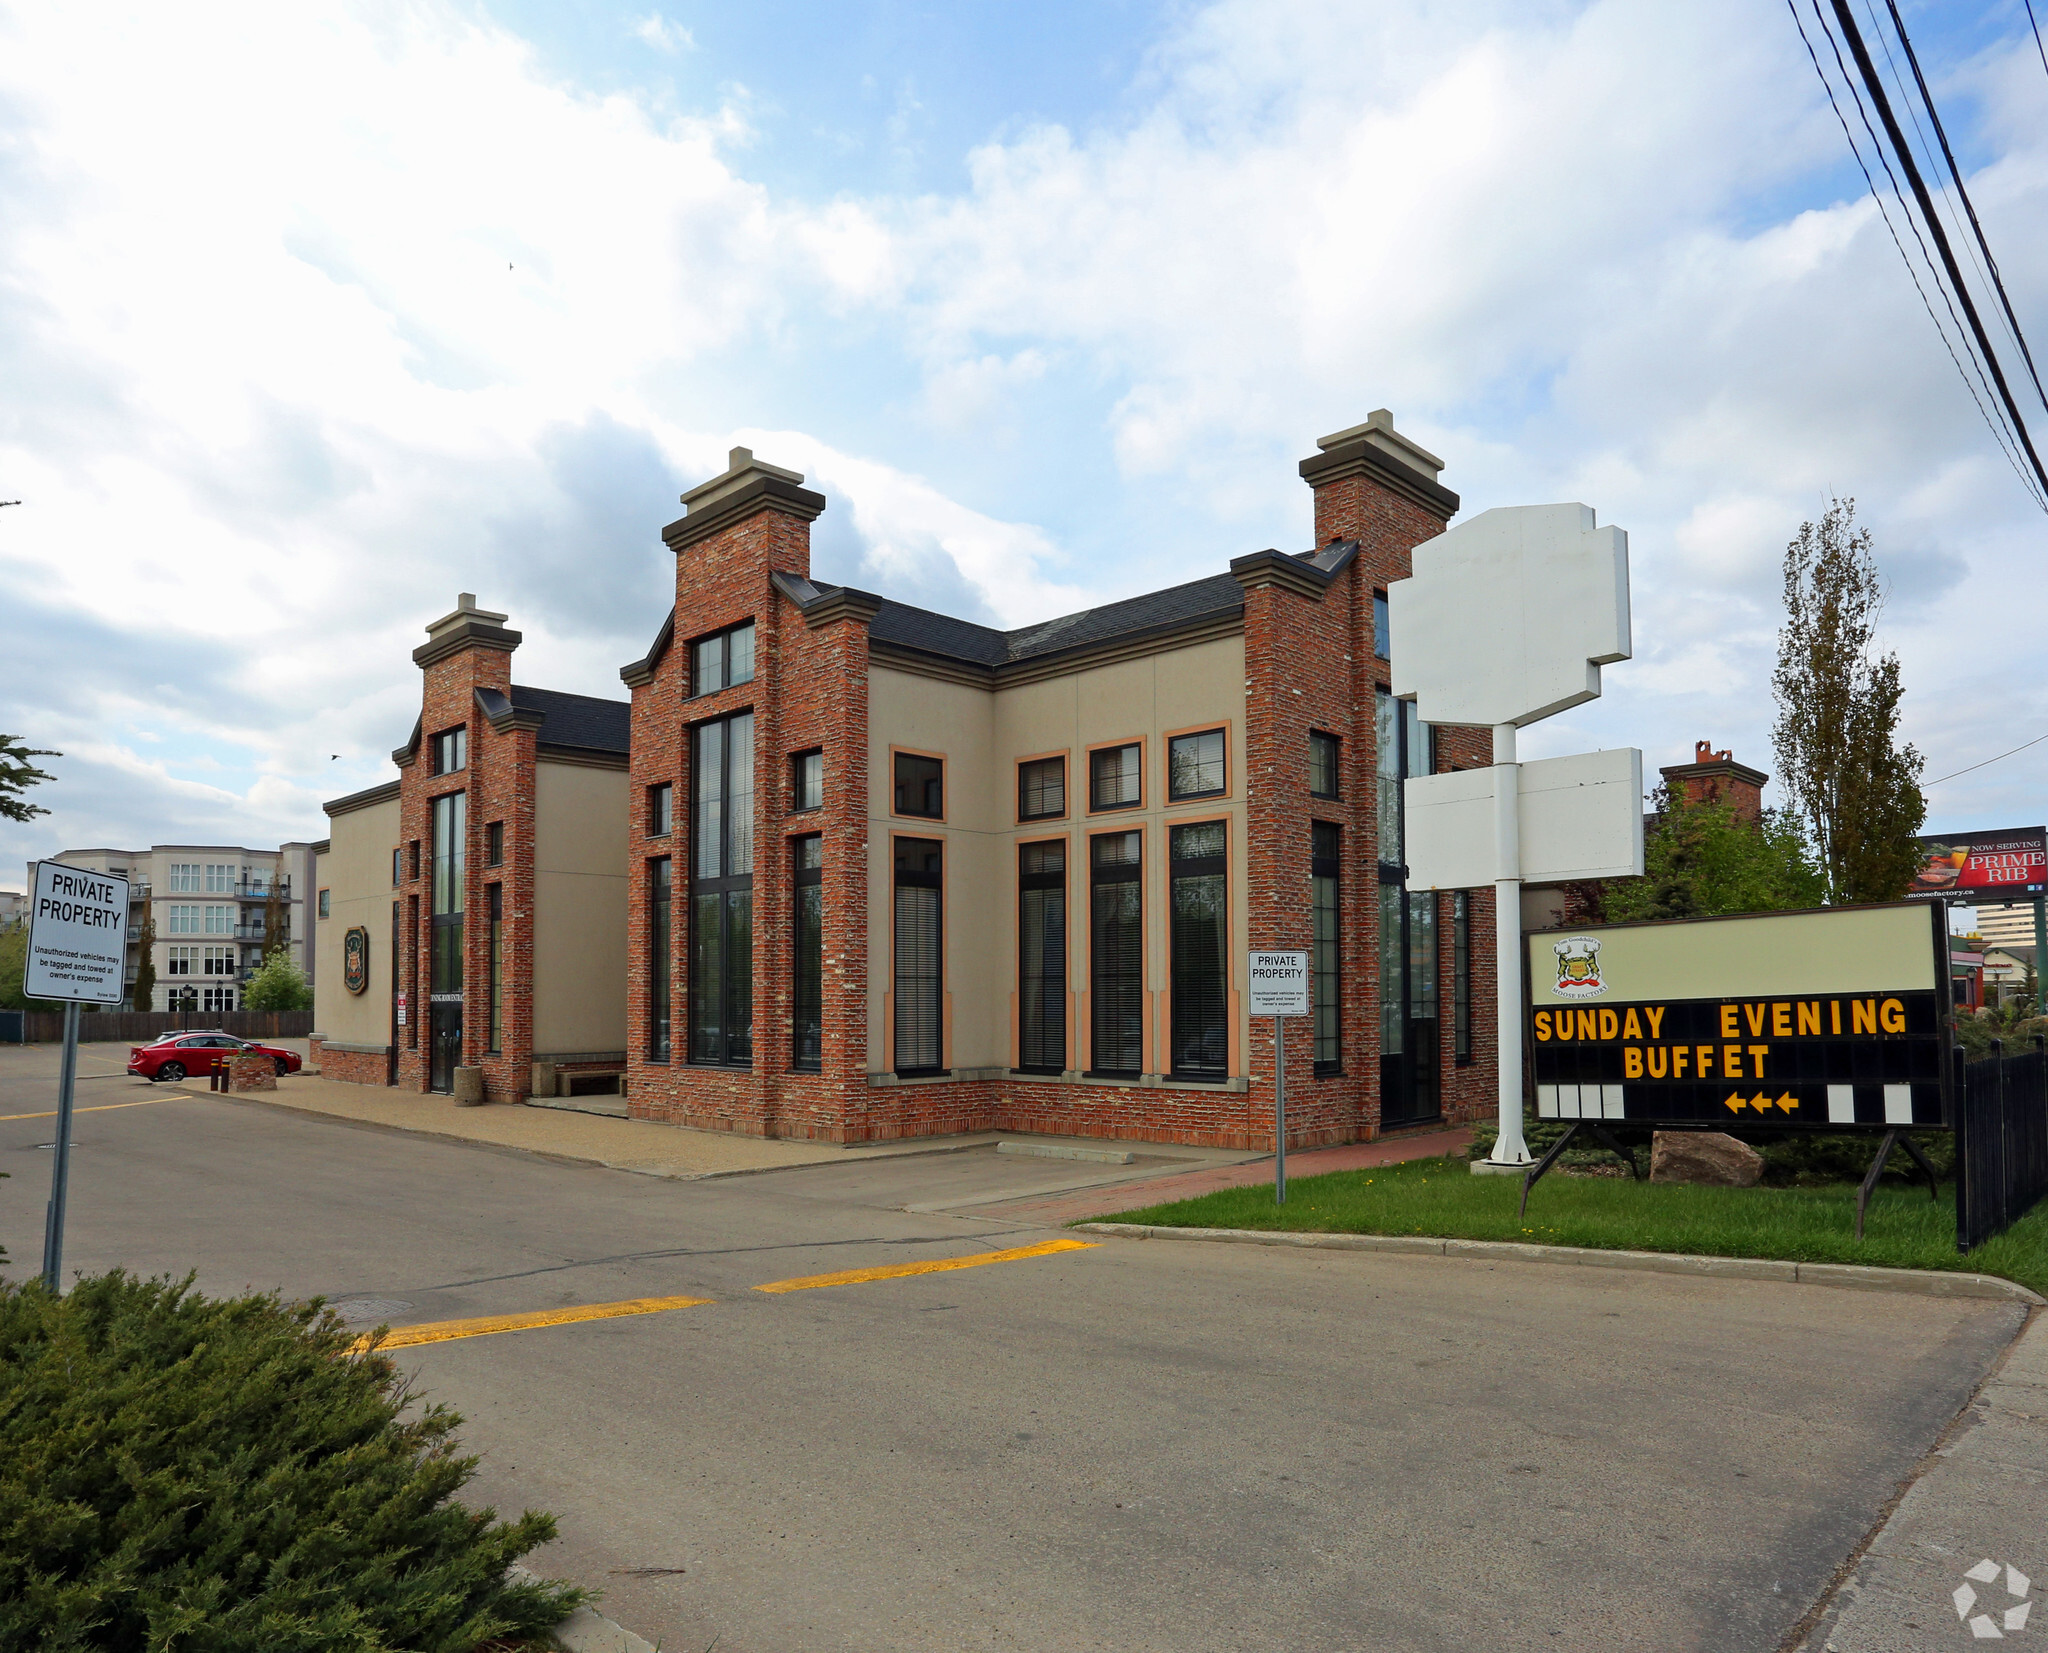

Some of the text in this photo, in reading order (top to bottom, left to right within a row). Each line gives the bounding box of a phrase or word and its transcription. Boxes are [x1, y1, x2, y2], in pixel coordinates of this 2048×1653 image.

[1972, 841, 2041, 852] NOW SERVING
[1969, 852, 2046, 870] PRIME
[1987, 867, 2029, 882] RIB
[52, 873, 114, 904] PRIVATE
[39, 898, 121, 930] PROPERTY
[34, 945, 120, 965] Unauthorized vehicles may
[1258, 956, 1297, 966] PRIVATE
[39, 958, 49, 967] be
[49, 960, 73, 970] tagged
[74, 963, 86, 971] and
[87, 964, 106, 973] towed
[1252, 968, 1303, 978] PROPERTY
[49, 971, 104, 983] owner's expense
[1552, 985, 1607, 999] MOOSE FACTORY
[1535, 998, 1906, 1041] SUNDAY EVENING
[1624, 1044, 1769, 1079] BUFFET
